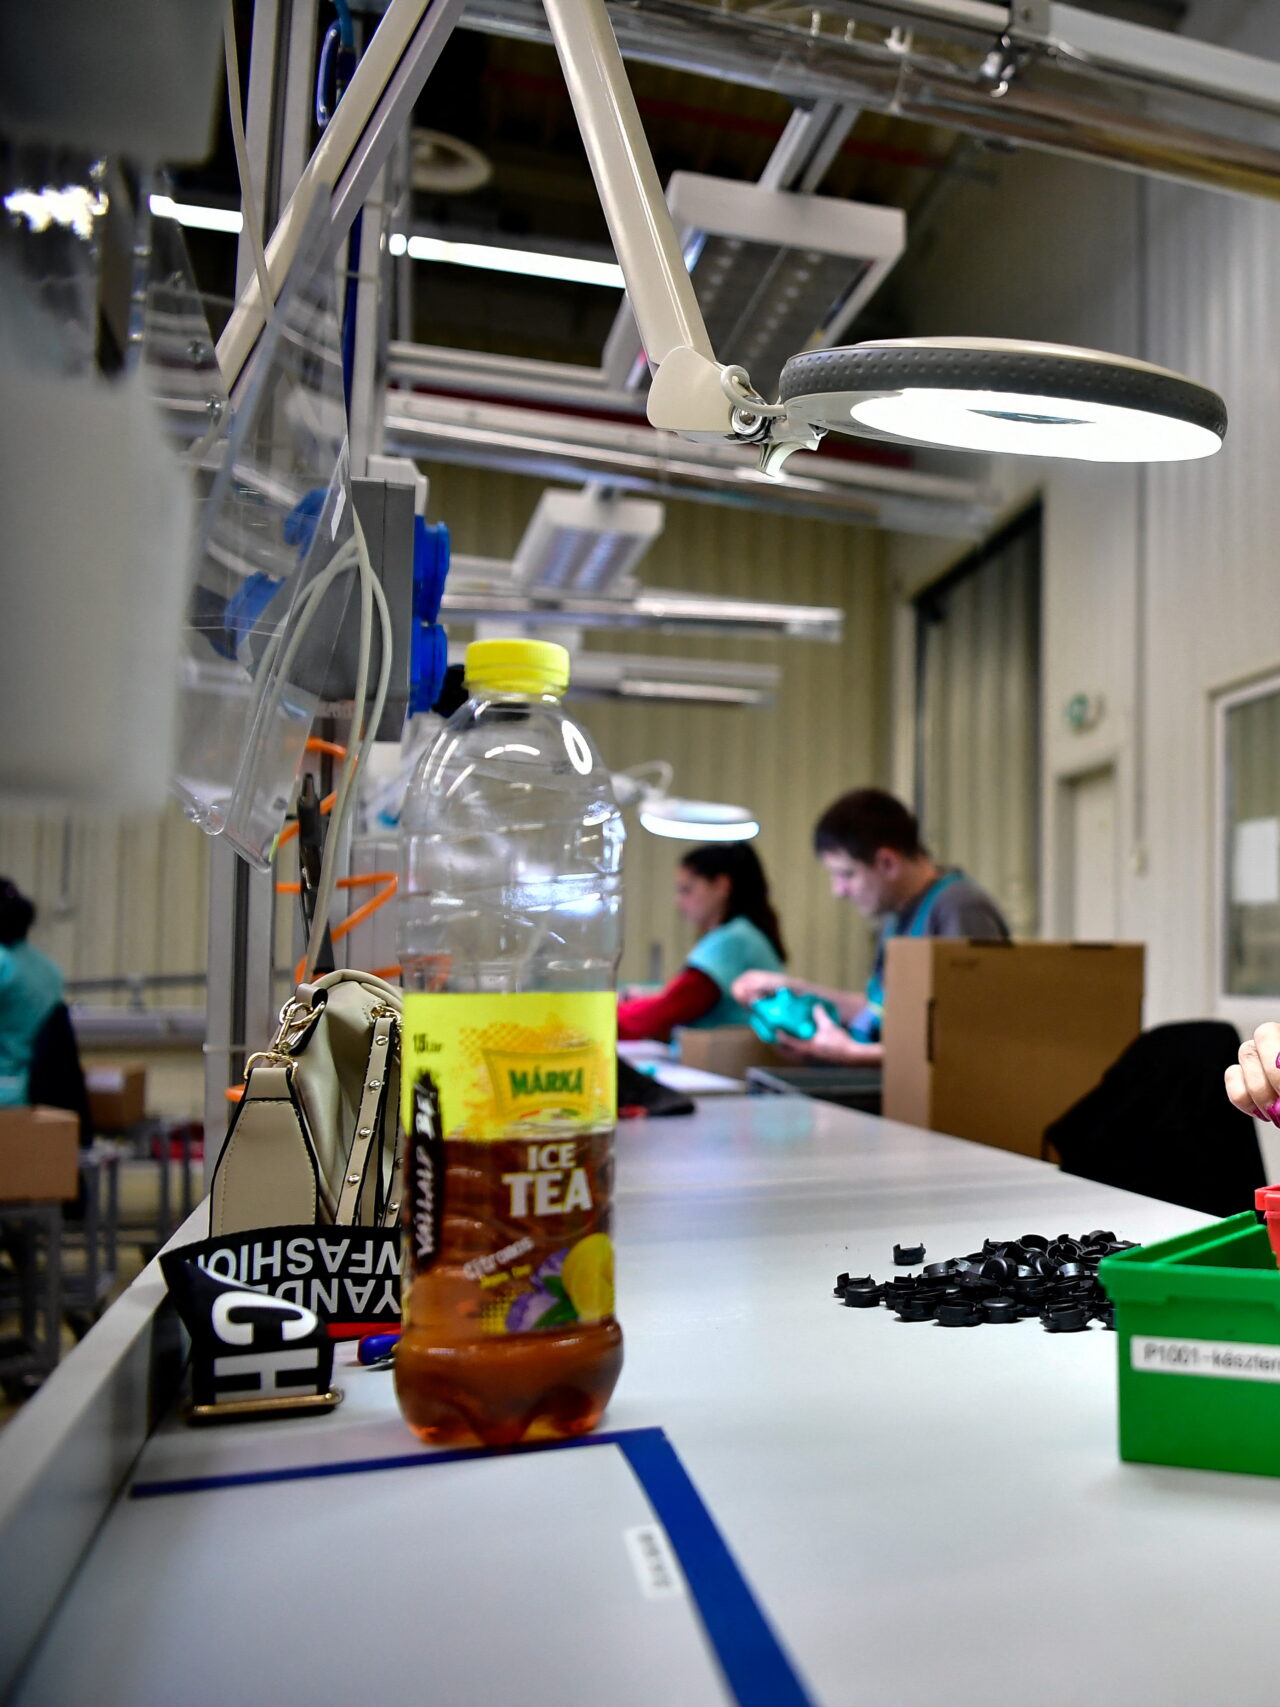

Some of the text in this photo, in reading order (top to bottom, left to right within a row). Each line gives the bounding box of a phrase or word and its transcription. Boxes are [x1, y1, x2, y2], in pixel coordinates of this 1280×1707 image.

[508, 1065, 583, 1108] MÁRKA
[527, 1142, 577, 1170] ICE
[503, 1168, 593, 1218] TEA
[254, 1278, 401, 1314] YAND
